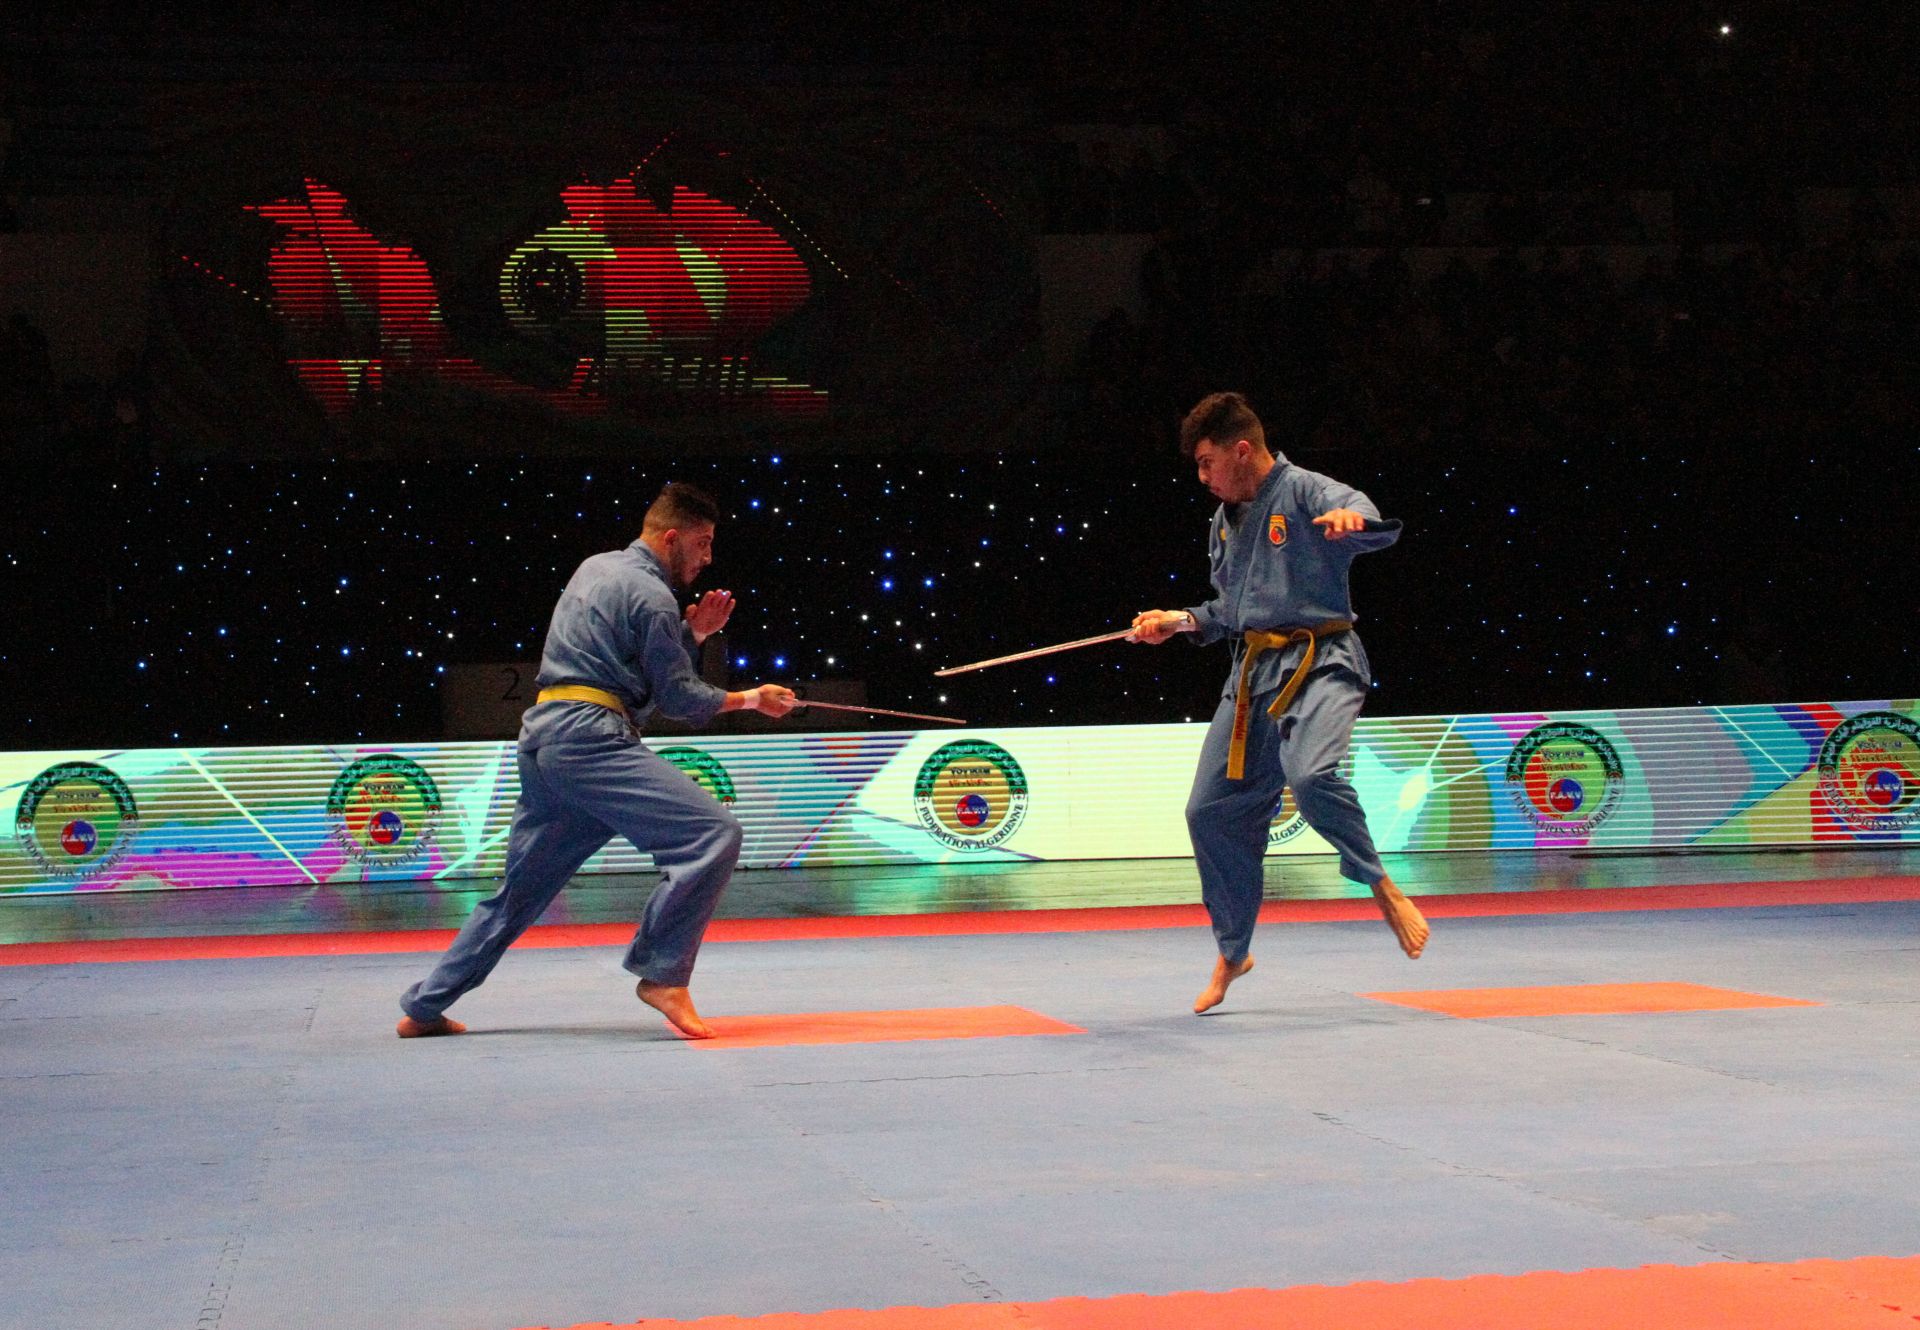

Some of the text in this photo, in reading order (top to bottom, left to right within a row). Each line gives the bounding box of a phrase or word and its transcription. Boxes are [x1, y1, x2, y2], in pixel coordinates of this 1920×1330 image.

[502, 668, 520, 699] 2
[919, 803, 1024, 850] FEDERATION ALGERIENNE
